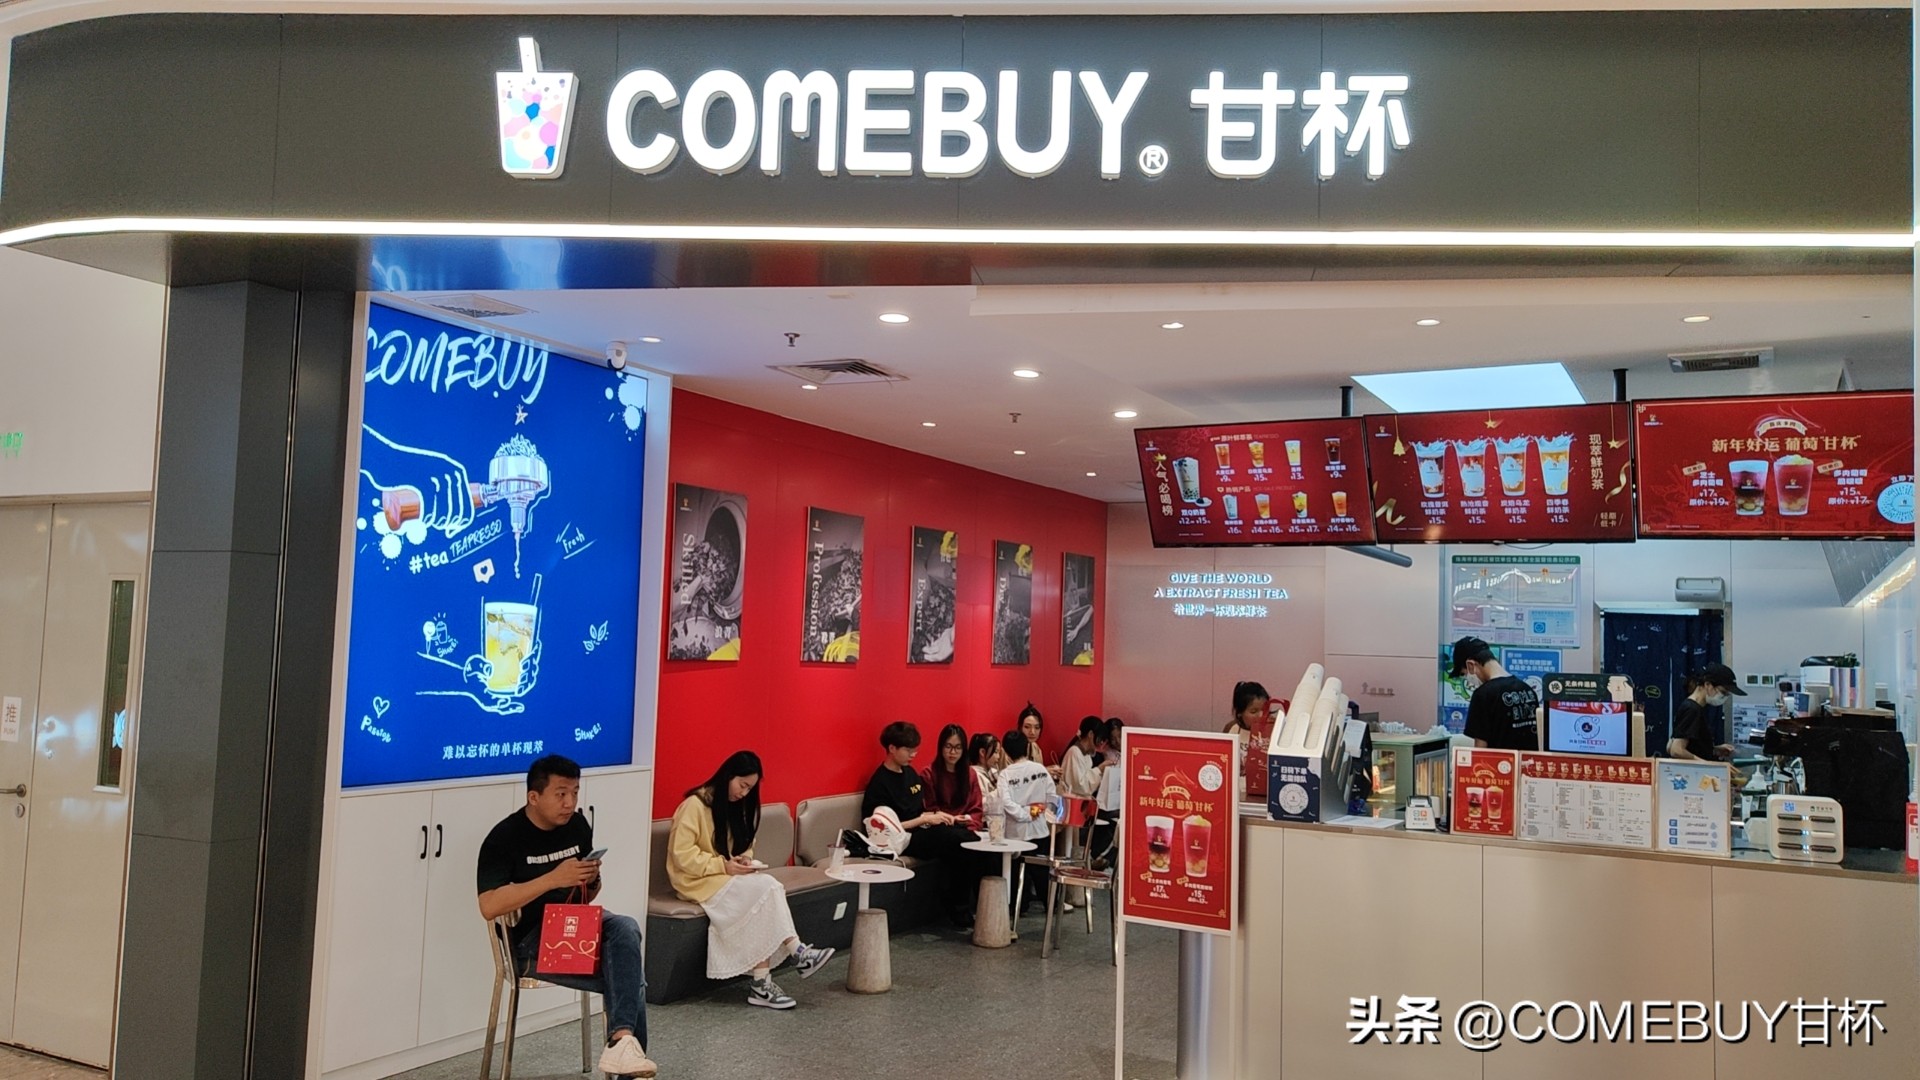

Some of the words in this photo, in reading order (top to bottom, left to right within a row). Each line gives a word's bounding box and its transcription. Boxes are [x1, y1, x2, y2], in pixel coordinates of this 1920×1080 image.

[606, 69, 1150, 180] COMEBUY
[1190, 71, 1412, 180] 甘杯
[1712, 437, 1780, 453] 新年好运
[450, 519, 503, 557] TEAPRESSO
[680, 533, 695, 605] Skilled
[1169, 573, 1199, 584] GIVE
[1200, 573, 1225, 584] THE
[1225, 573, 1272, 584] WORLD
[809, 541, 825, 638] Profession
[1154, 587, 1164, 598] A
[1166, 587, 1221, 598] EXTRACT
[1222, 588, 1260, 599] FRESH
[1263, 588, 1288, 599] TEA
[915, 578, 926, 632] Expert
[442, 740, 544, 760] 难以忘怀的单杯现萃
[1139, 796, 1173, 809] 新年好运
[548, 845, 580, 862] NURSERY
